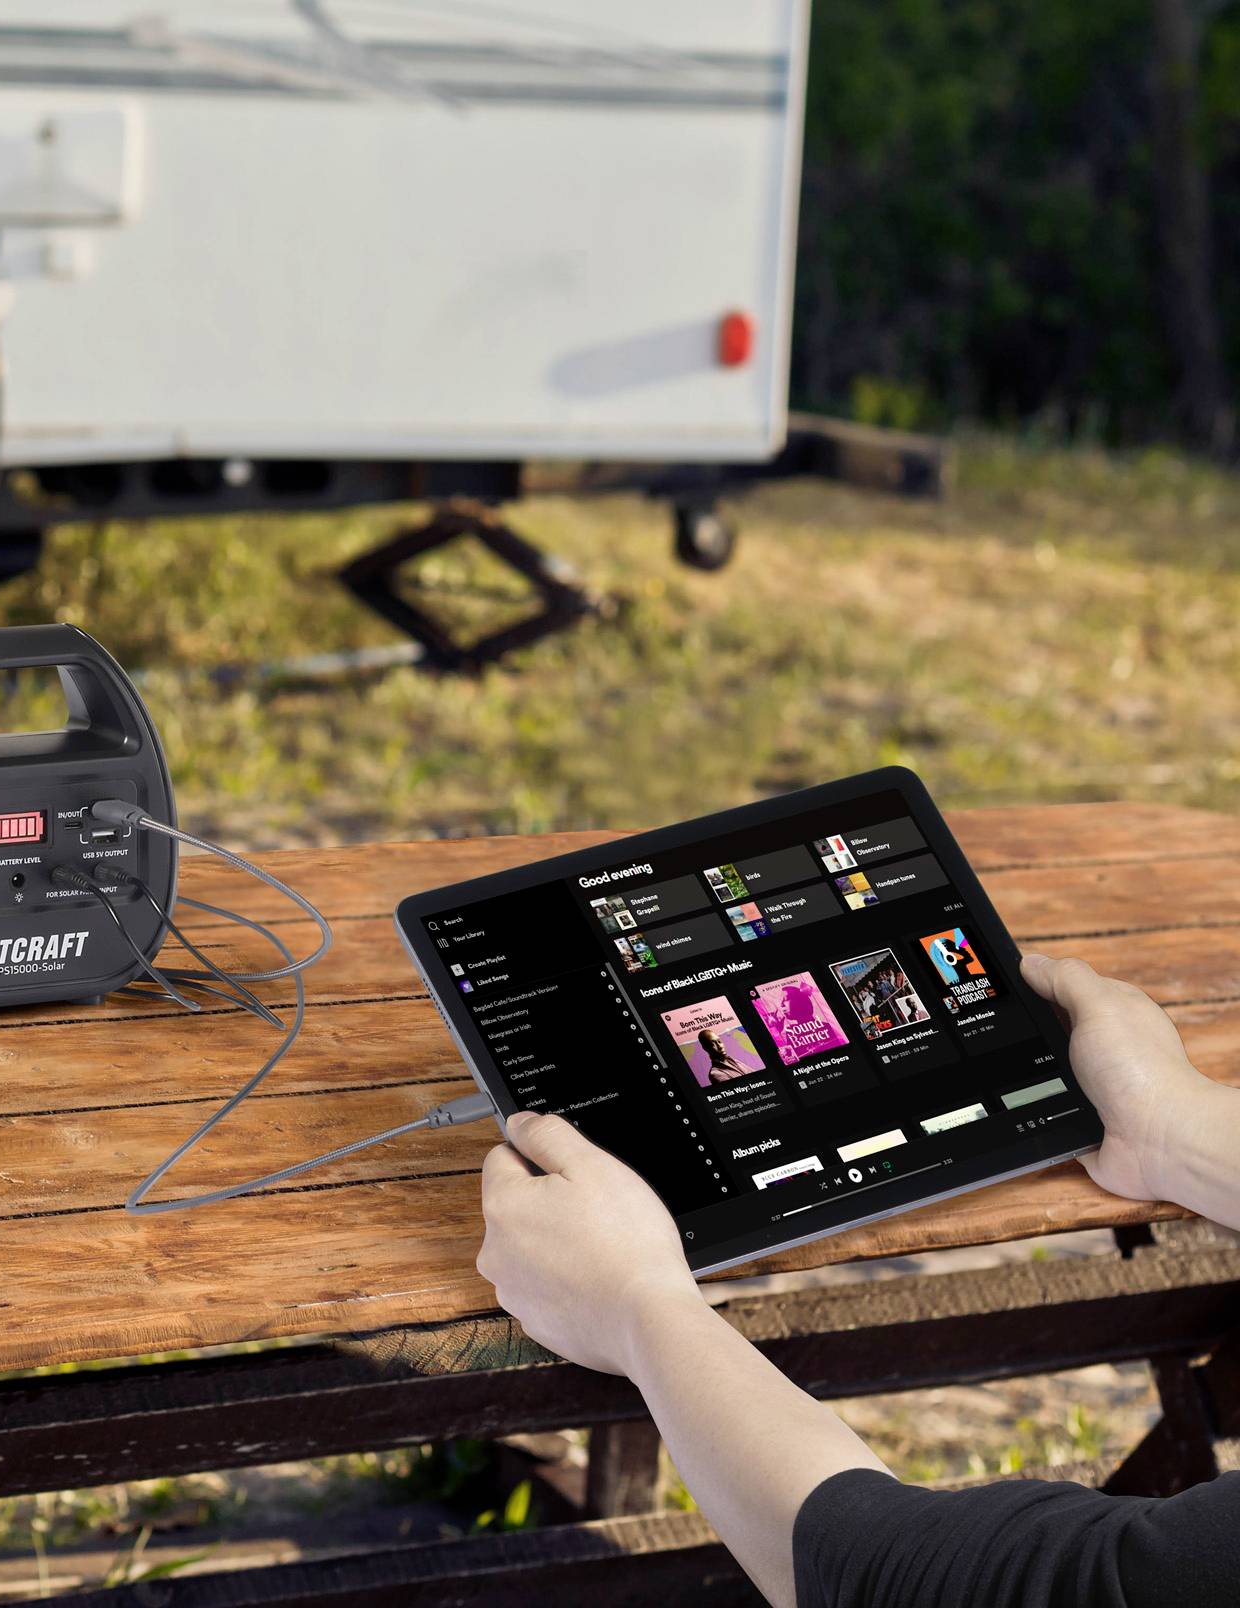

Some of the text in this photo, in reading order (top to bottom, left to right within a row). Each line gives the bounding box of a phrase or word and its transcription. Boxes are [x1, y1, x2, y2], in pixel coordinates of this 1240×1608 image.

[58, 811, 80, 819] IN/OUT
[104, 849, 128, 857] OUTPUT
[856, 843, 890, 856] Observatory
[24, 857, 41, 865] LEVEL
[579, 863, 653, 888] Good evening
[745, 872, 761, 881] birds
[875, 877, 901, 888] Handpan
[630, 894, 658, 905] Stephane
[767, 904, 783, 912] Walk
[781, 898, 806, 908] Through
[636, 905, 660, 916] Grapelli
[443, 916, 463, 926] Search
[465, 931, 485, 939] Library
[655, 936, 692, 949] wind chimes
[467, 955, 506, 969] Create Playlist
[476, 974, 509, 986] Liked Songs
[640, 960, 753, 998] Icons of Black LGBTQ+ Music
[950, 977, 991, 996] TRANSLASH
[957, 989, 988, 1005] PODCAST
[473, 1002, 494, 1013] Bagdad
[496, 1009, 529, 1021] Observatory
[678, 1018, 696, 1028] Born
[693, 1014, 709, 1024] This
[706, 1010, 723, 1021] Way
[957, 1016, 976, 1026] Janelle
[784, 1017, 824, 1037] Sound
[789, 1028, 830, 1048] Barrier
[876, 1042, 893, 1051] Jason
[891, 1038, 907, 1046] King
[494, 1045, 510, 1053] birds
[517, 1054, 534, 1062] Simon
[797, 1065, 815, 1074] Night
[830, 1055, 849, 1064] Opera
[524, 1068, 540, 1077] Davis
[539, 1064, 556, 1072] artists
[517, 1085, 536, 1094] Cream
[707, 1094, 722, 1102] Born
[721, 1090, 735, 1098] This
[749, 1081, 766, 1089] Icons
[526, 1098, 546, 1108] crickets
[569, 1100, 593, 1110] Platinum
[592, 1092, 619, 1103] Collection
[715, 1106, 730, 1114] Jason
[759, 1090, 777, 1100] Sound
[732, 1138, 781, 1160] Album picks
